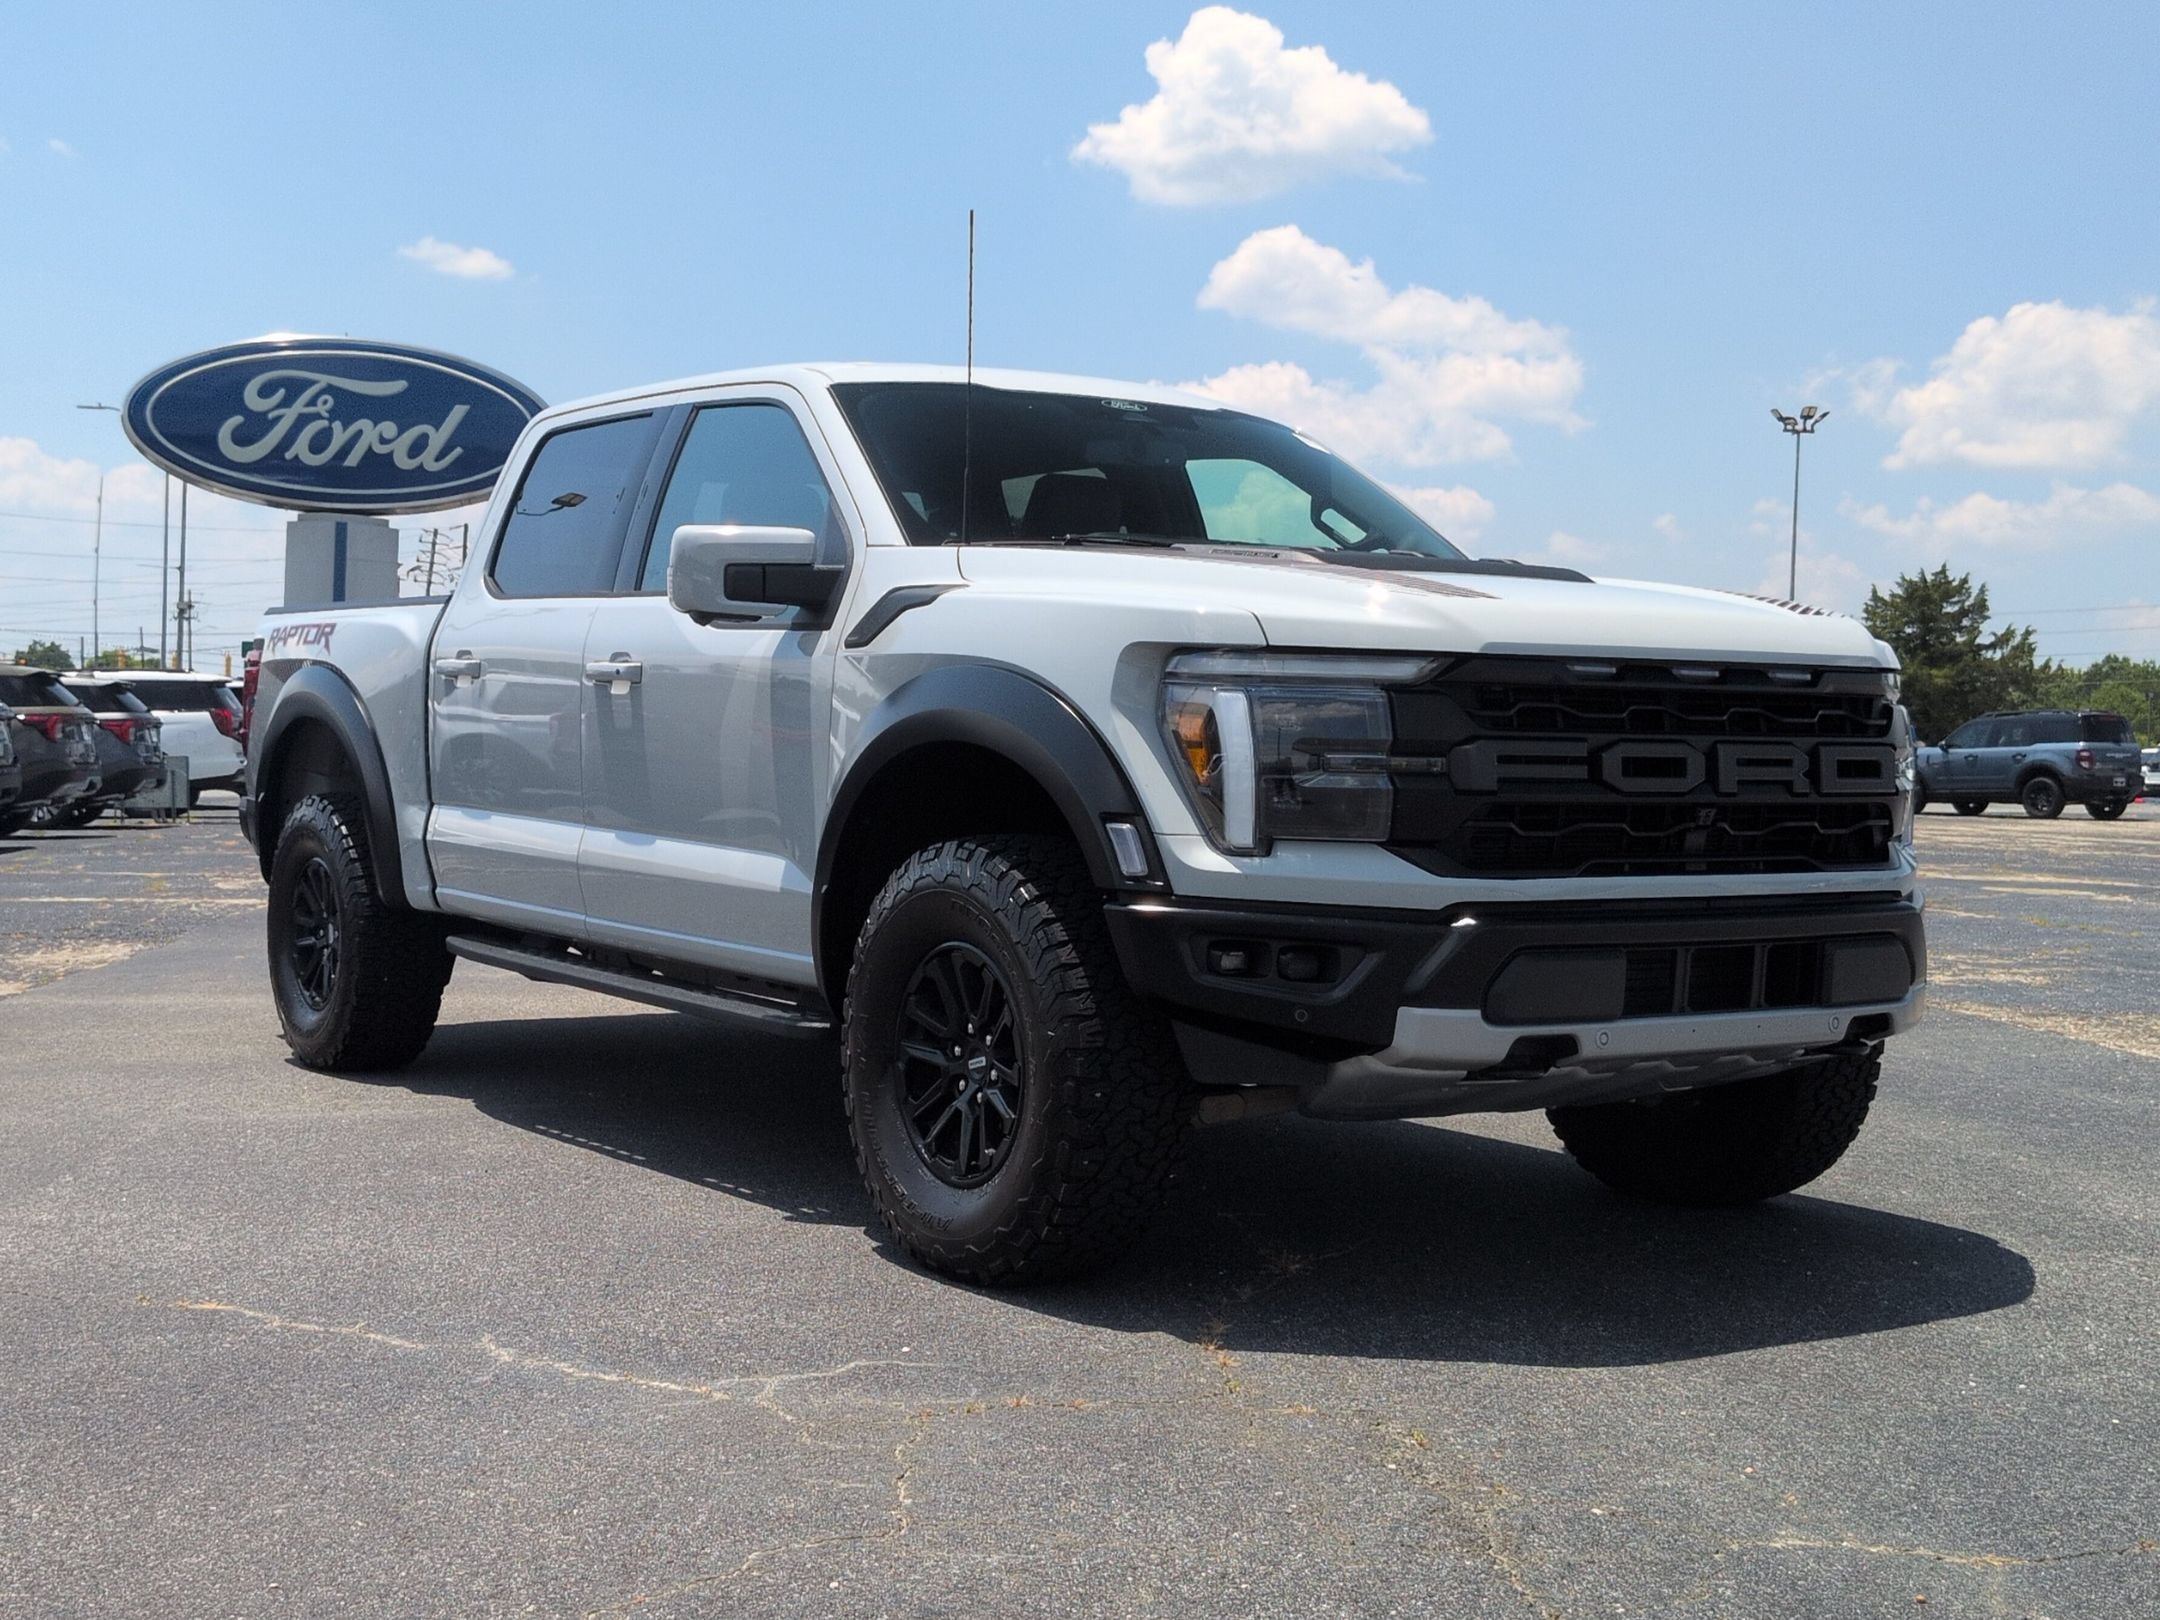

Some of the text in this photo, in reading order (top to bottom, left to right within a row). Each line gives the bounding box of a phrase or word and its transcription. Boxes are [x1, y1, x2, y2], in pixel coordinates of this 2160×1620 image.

[217, 369, 471, 472] Ford
[266, 622, 337, 656] RAPTOR
[1448, 738, 1898, 795] FORD
